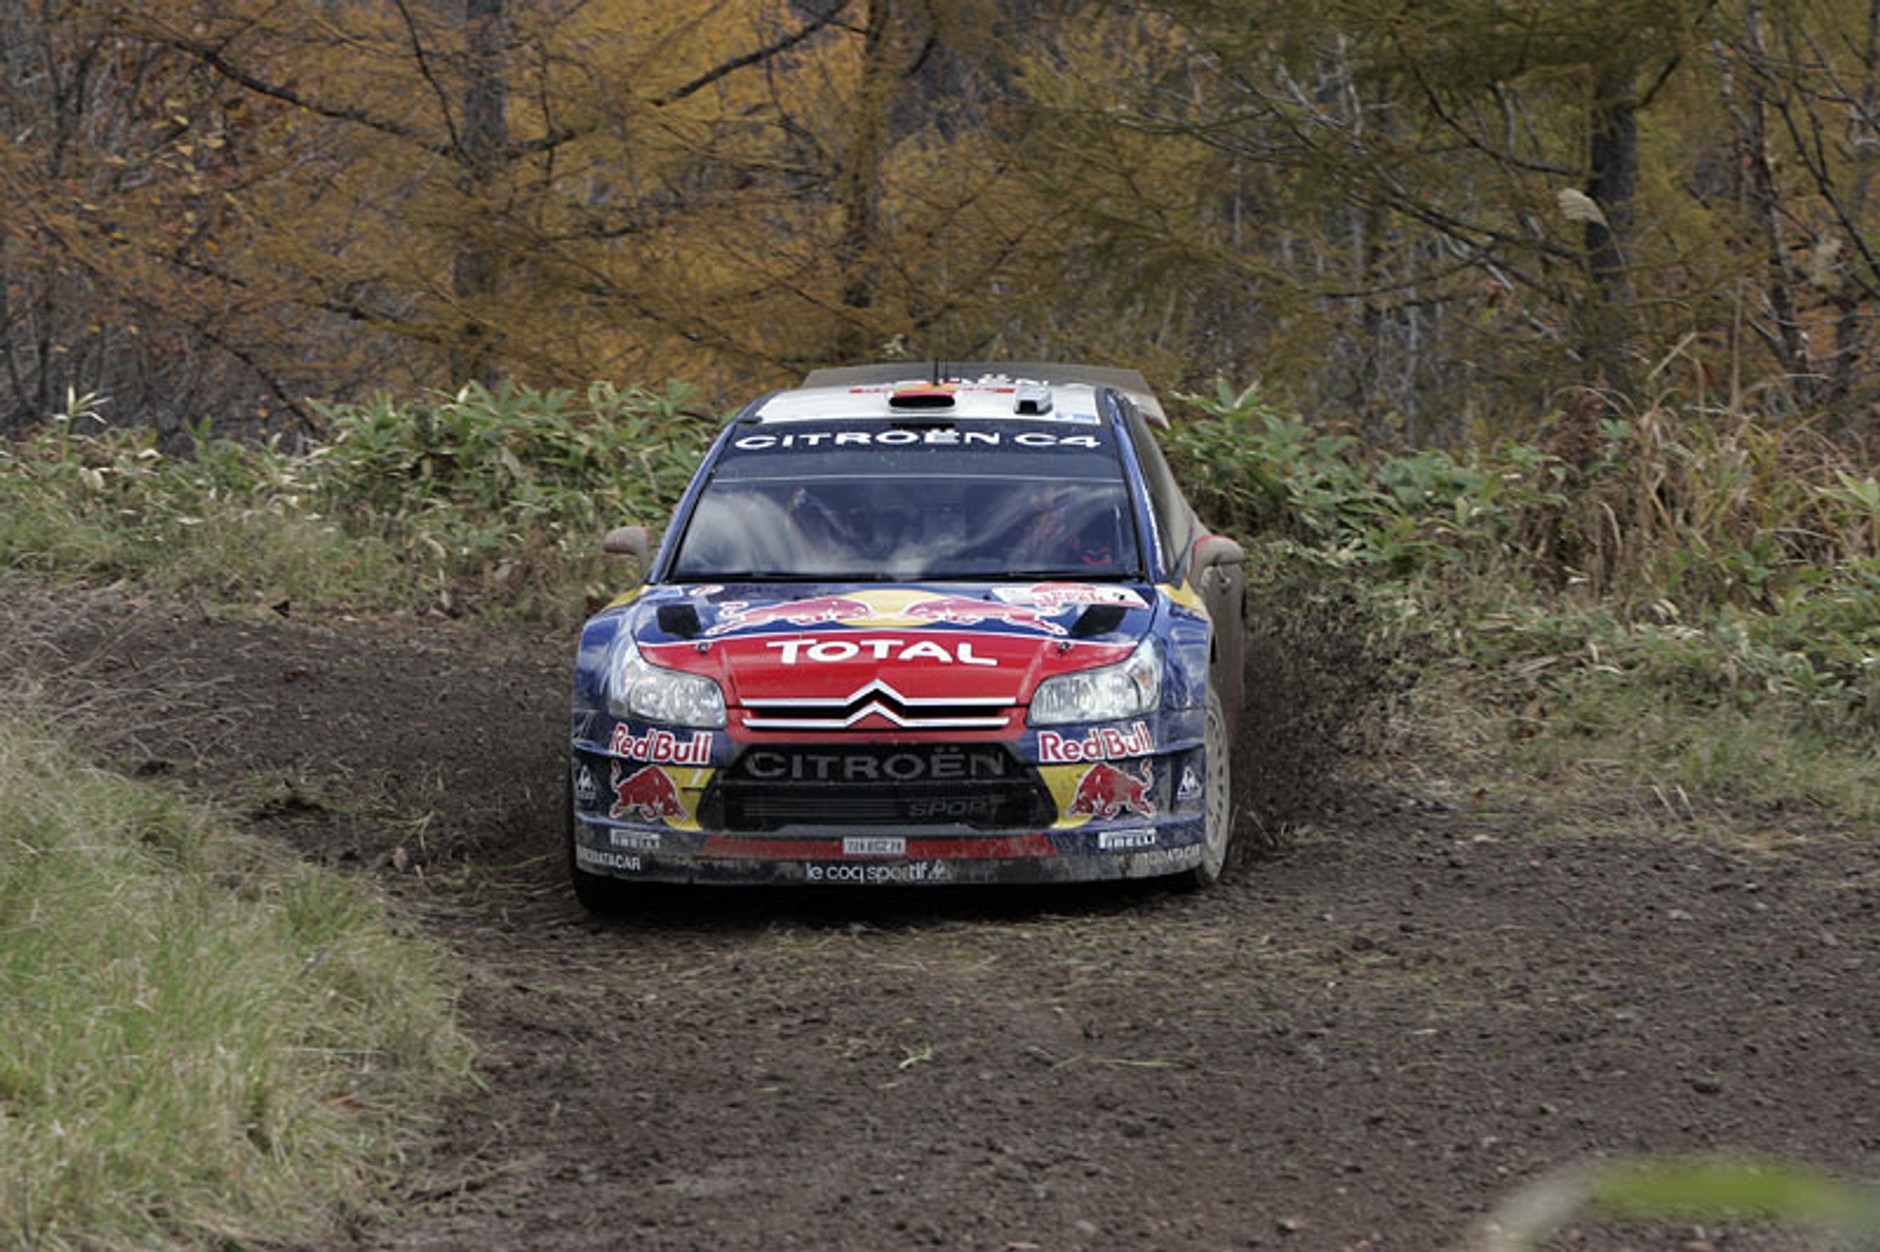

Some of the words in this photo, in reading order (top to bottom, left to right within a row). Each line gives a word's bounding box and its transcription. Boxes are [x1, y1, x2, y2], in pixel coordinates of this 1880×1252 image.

[735, 427, 1000, 450] CITROËN
[1014, 432, 1101, 449] C4
[766, 639, 998, 666] TOTAL
[609, 722, 656, 760] Red
[654, 731, 712, 764] Bull
[1039, 728, 1104, 762] Red
[1103, 721, 1155, 757] Bull
[745, 747, 1006, 780] CITROËN
[908, 794, 1006, 818] SPORT
[1099, 827, 1156, 849] PIRELLI
[805, 862, 823, 880] le
[826, 866, 864, 884] coq
[867, 862, 928, 884] sportif
